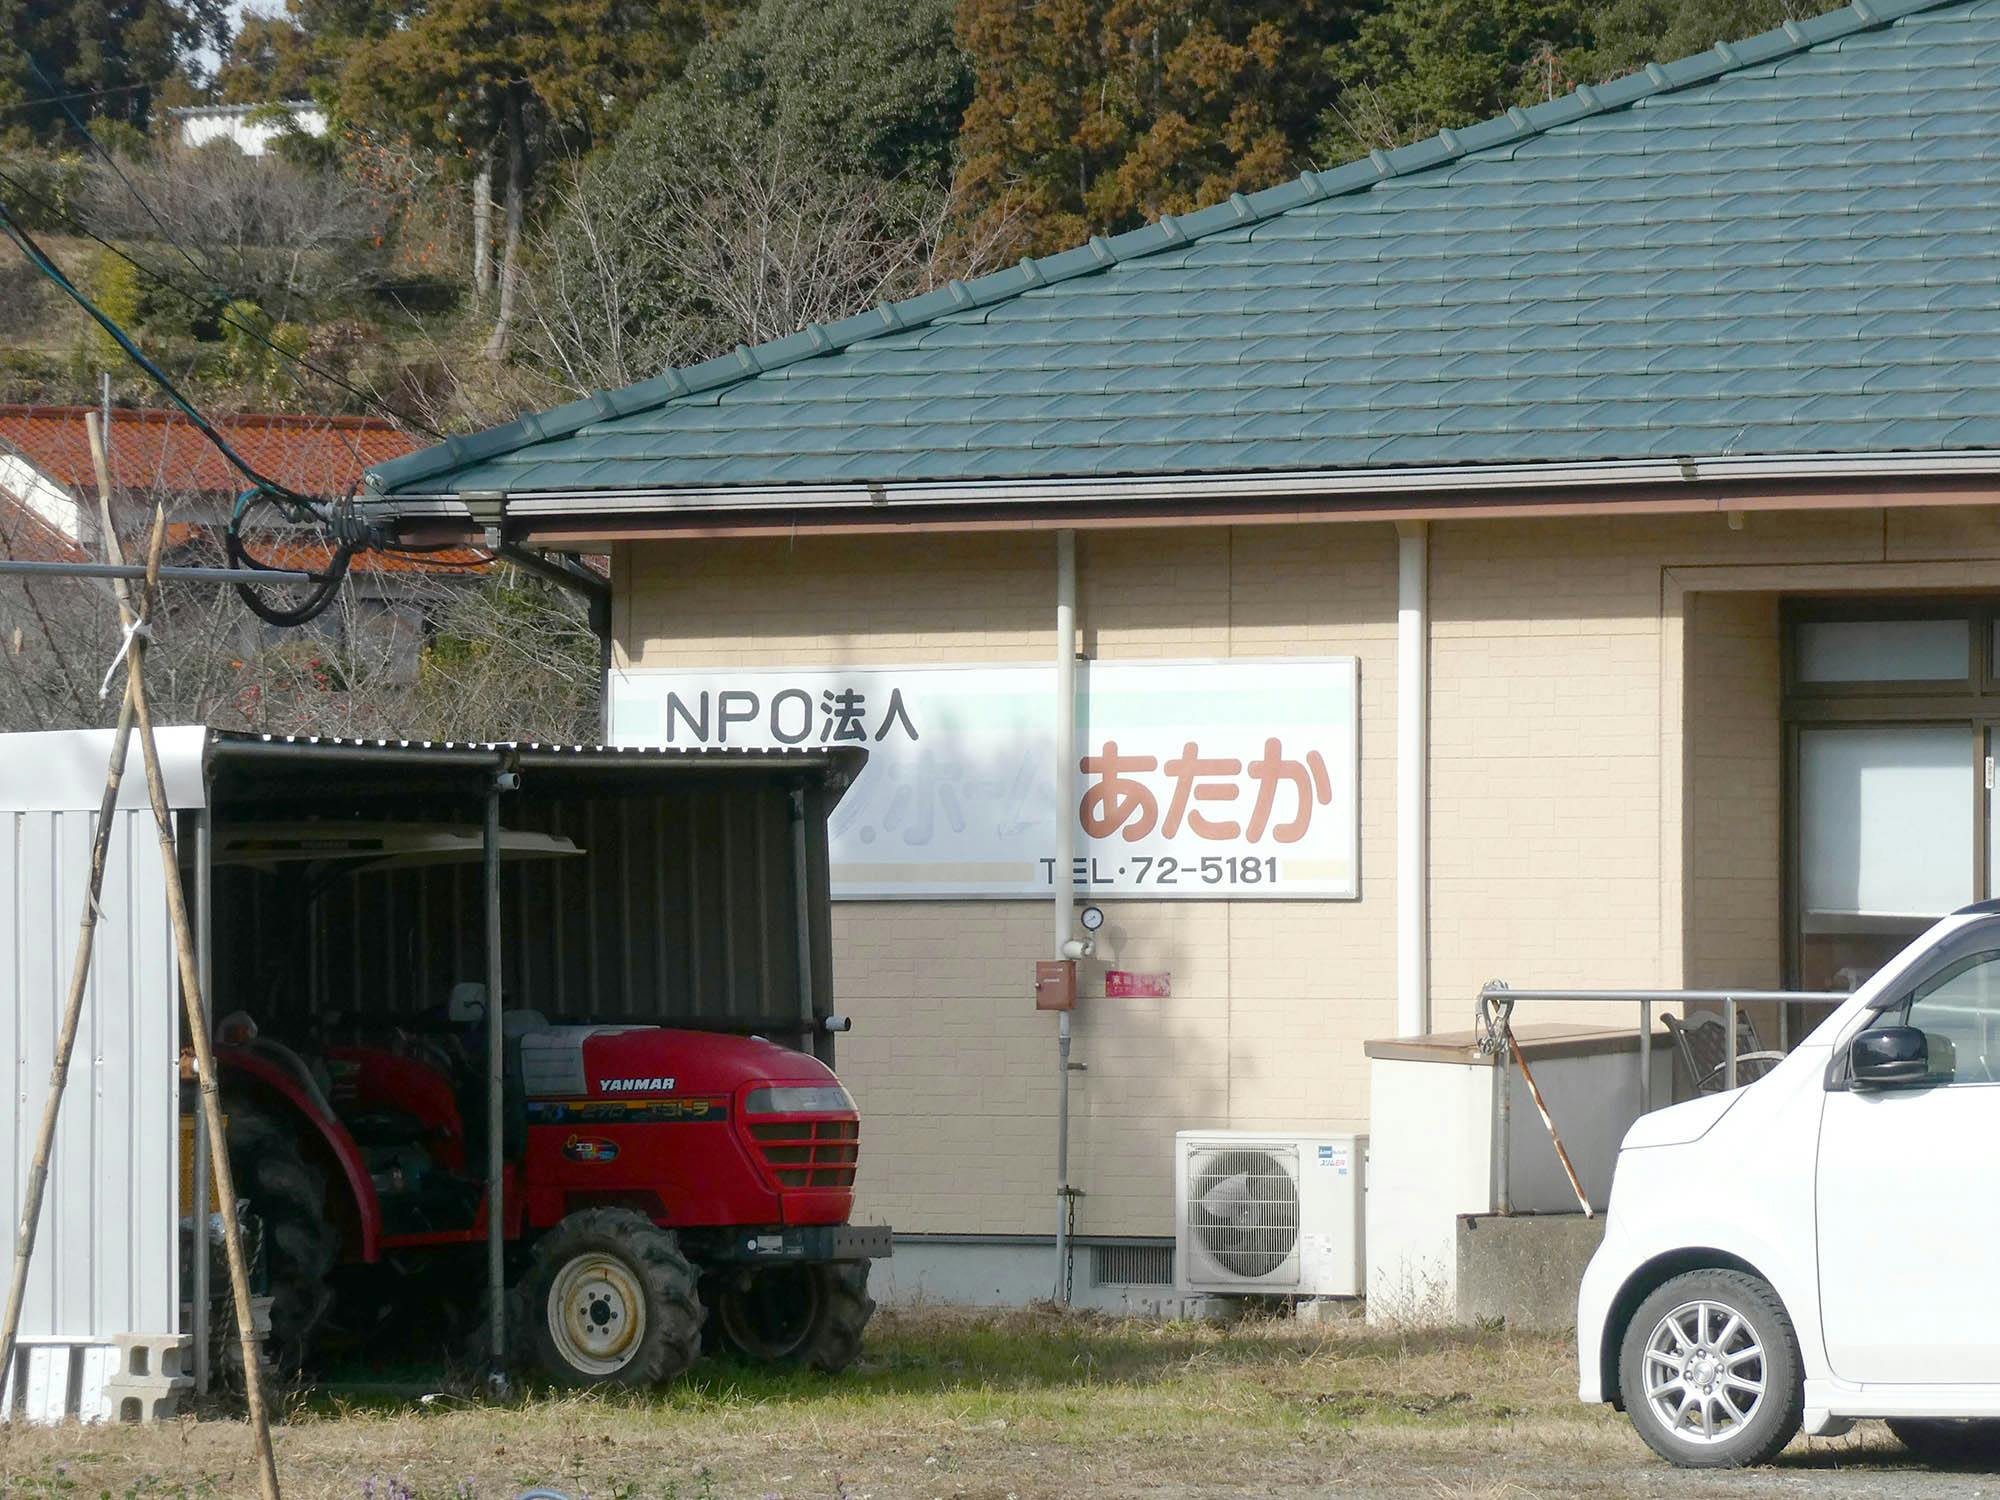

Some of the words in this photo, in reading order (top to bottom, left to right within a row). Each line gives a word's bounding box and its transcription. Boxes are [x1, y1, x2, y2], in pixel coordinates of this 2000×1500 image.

[666, 688, 919, 744] NPO法人
[1079, 737, 1332, 843] あたか
[600, 1078, 676, 1091] YANMAR
